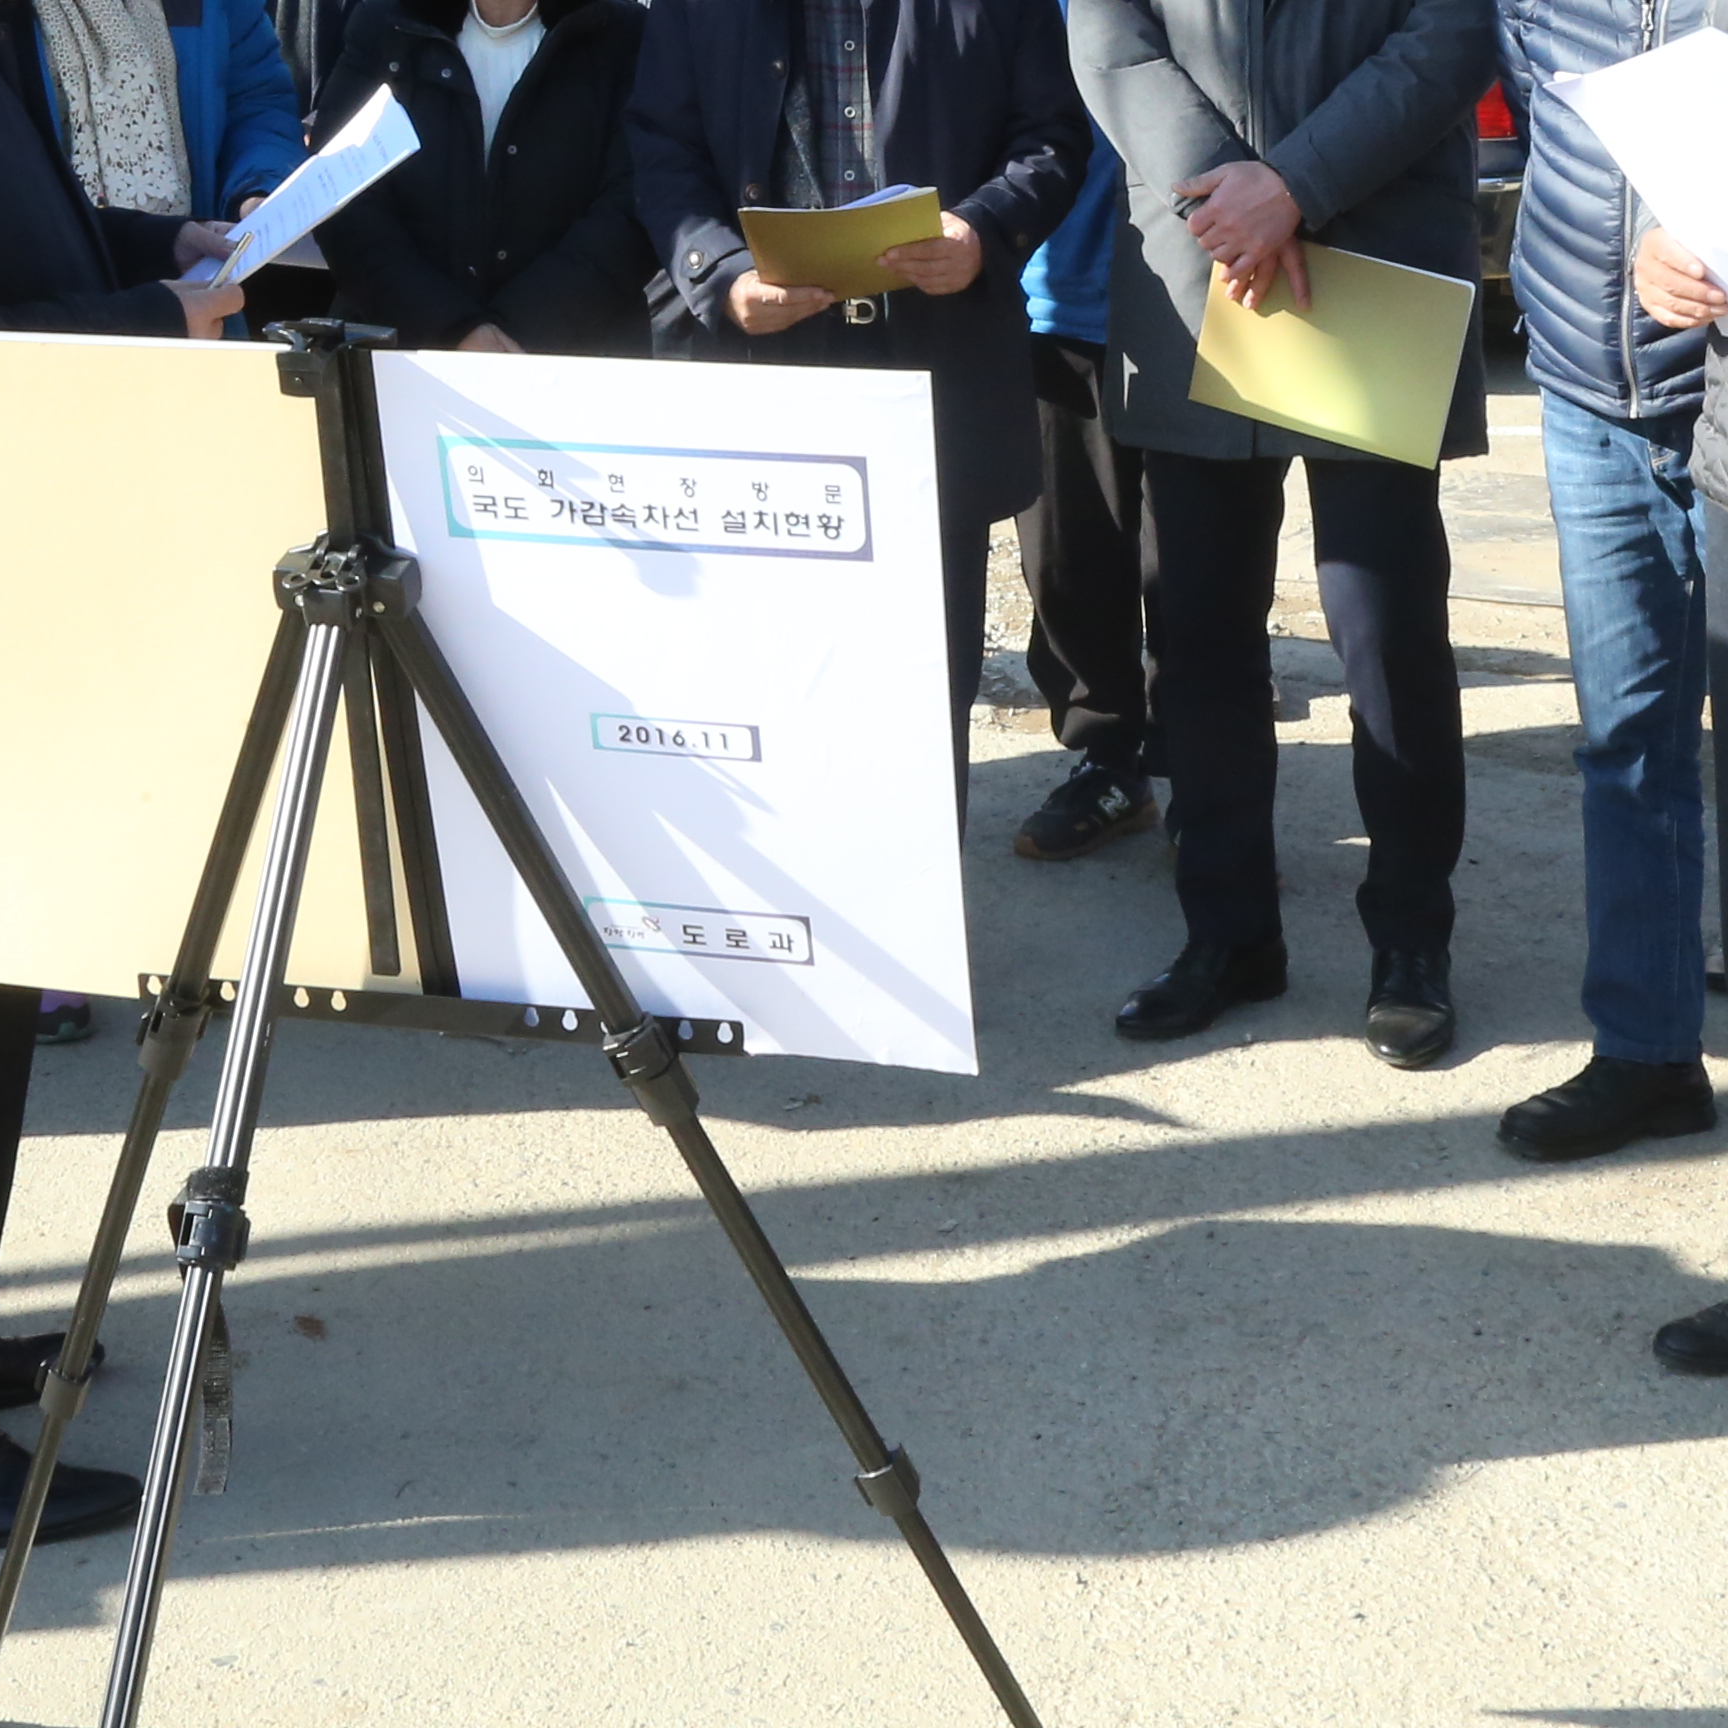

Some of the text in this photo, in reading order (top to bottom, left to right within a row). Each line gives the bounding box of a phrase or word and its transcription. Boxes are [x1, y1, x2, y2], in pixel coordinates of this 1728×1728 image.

[472, 494, 846, 541] 국도 가감속차선 설치현황
[618, 725, 729, 751] 2016.11
